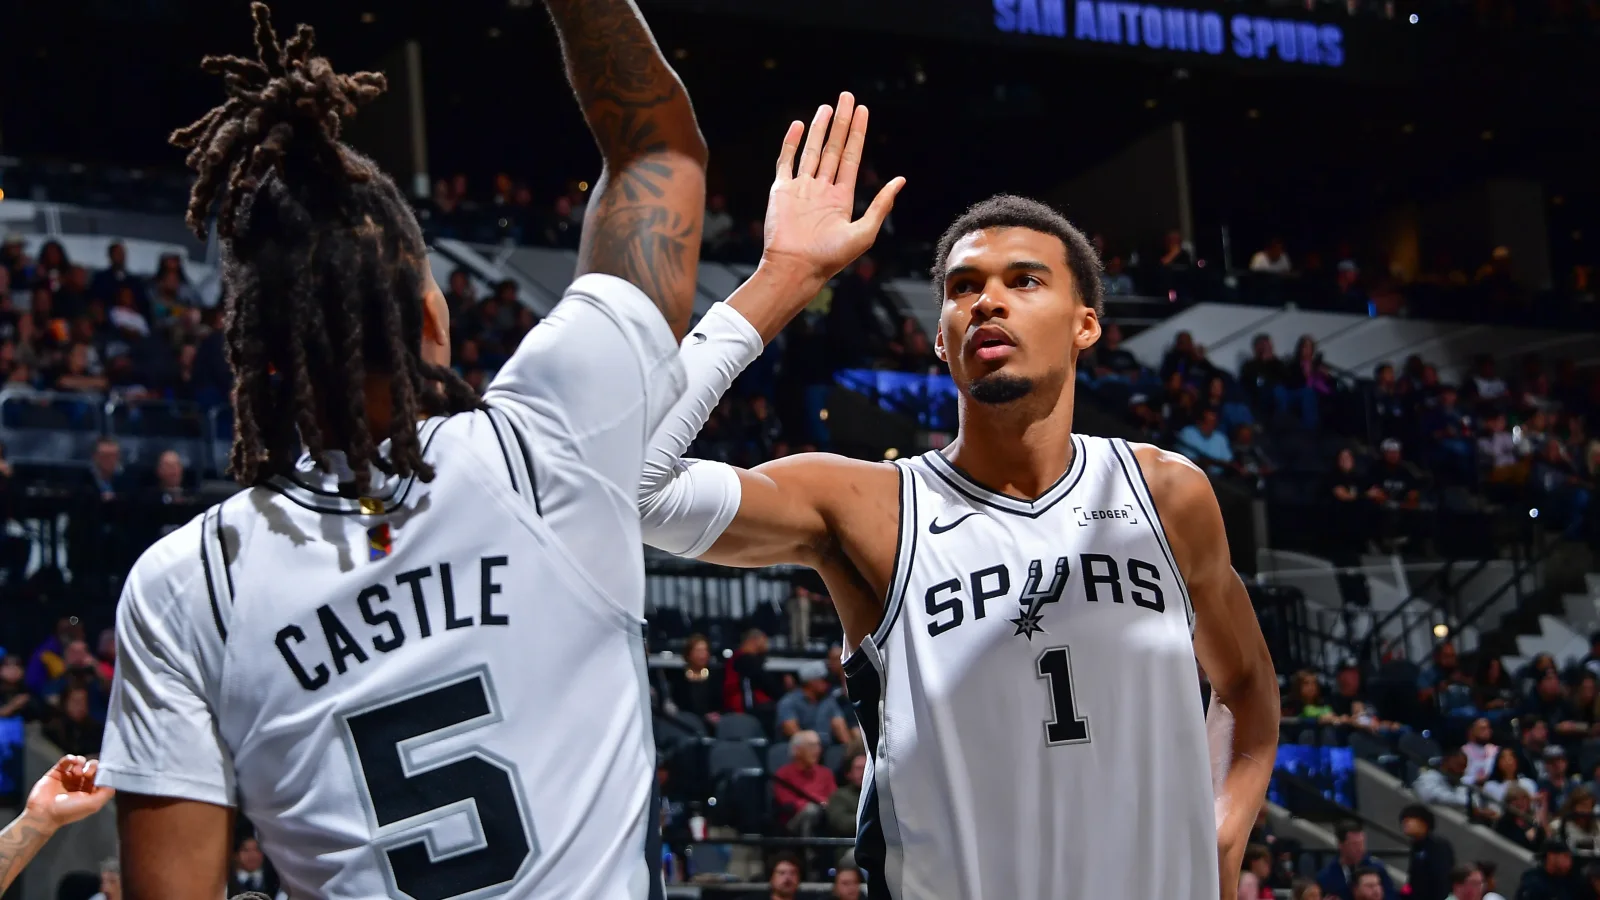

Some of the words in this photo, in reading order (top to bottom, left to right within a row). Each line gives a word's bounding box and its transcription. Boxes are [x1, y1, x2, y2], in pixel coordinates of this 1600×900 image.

[1074, 0, 1224, 55] ANTONIO
[1231, 14, 1344, 66] SPURS
[1083, 509, 1129, 520] LEDGER
[274, 555, 510, 691] CASTLE
[925, 553, 1165, 642] SPURS
[1034, 644, 1091, 748] 1
[332, 662, 542, 900] 5
